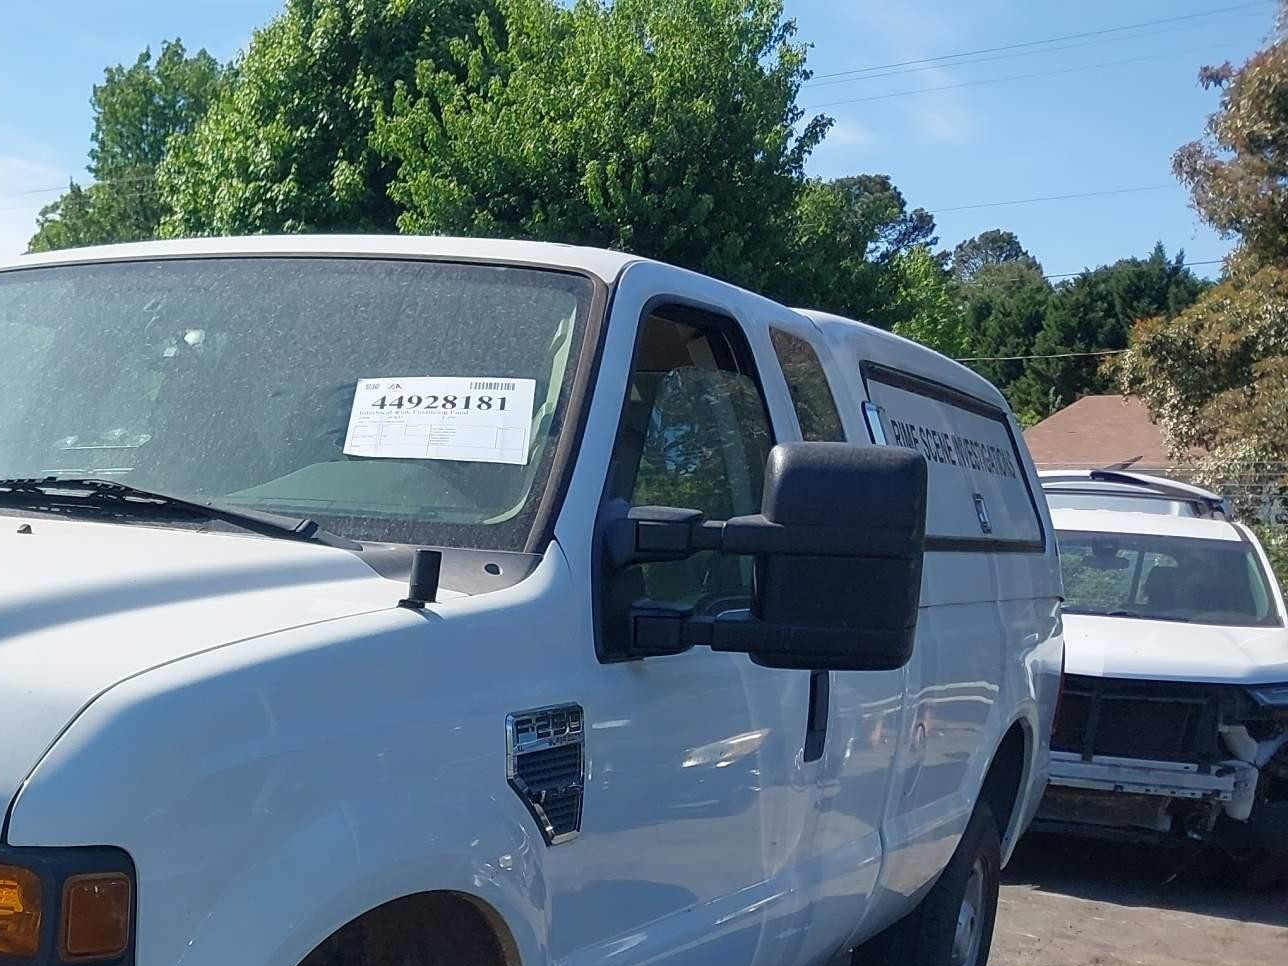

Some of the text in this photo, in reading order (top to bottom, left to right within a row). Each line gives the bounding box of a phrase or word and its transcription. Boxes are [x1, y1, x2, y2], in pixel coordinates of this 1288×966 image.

[372, 394, 509, 411] 44928181
[890, 419, 919, 450] RIME
[919, 426, 956, 466] SCENE
